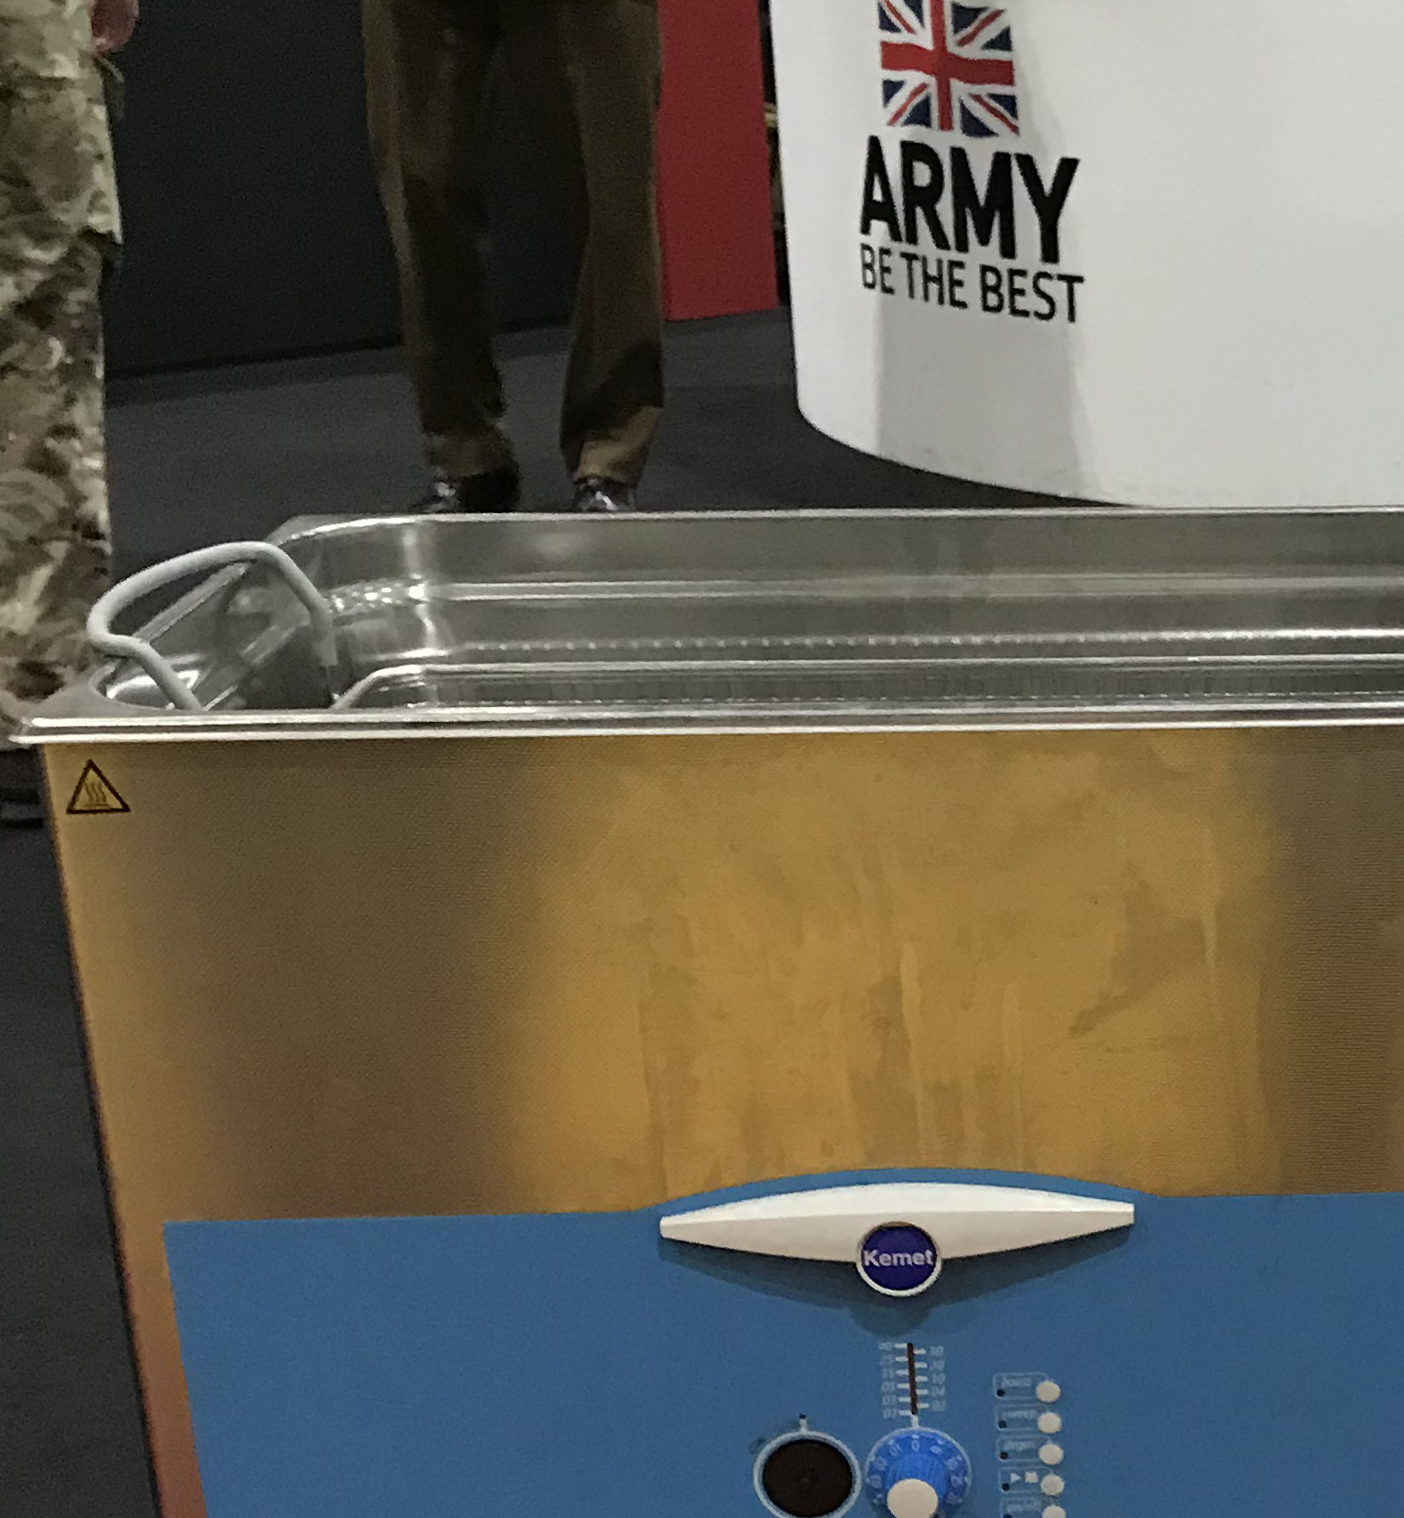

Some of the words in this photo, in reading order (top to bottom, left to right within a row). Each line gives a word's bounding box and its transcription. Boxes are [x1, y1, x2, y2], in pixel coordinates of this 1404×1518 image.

[860, 135, 1080, 264] ARMY
[860, 242, 895, 295] BE
[900, 251, 968, 309] THE
[979, 263, 1085, 323] BEST
[863, 1249, 934, 1267] Kemet
